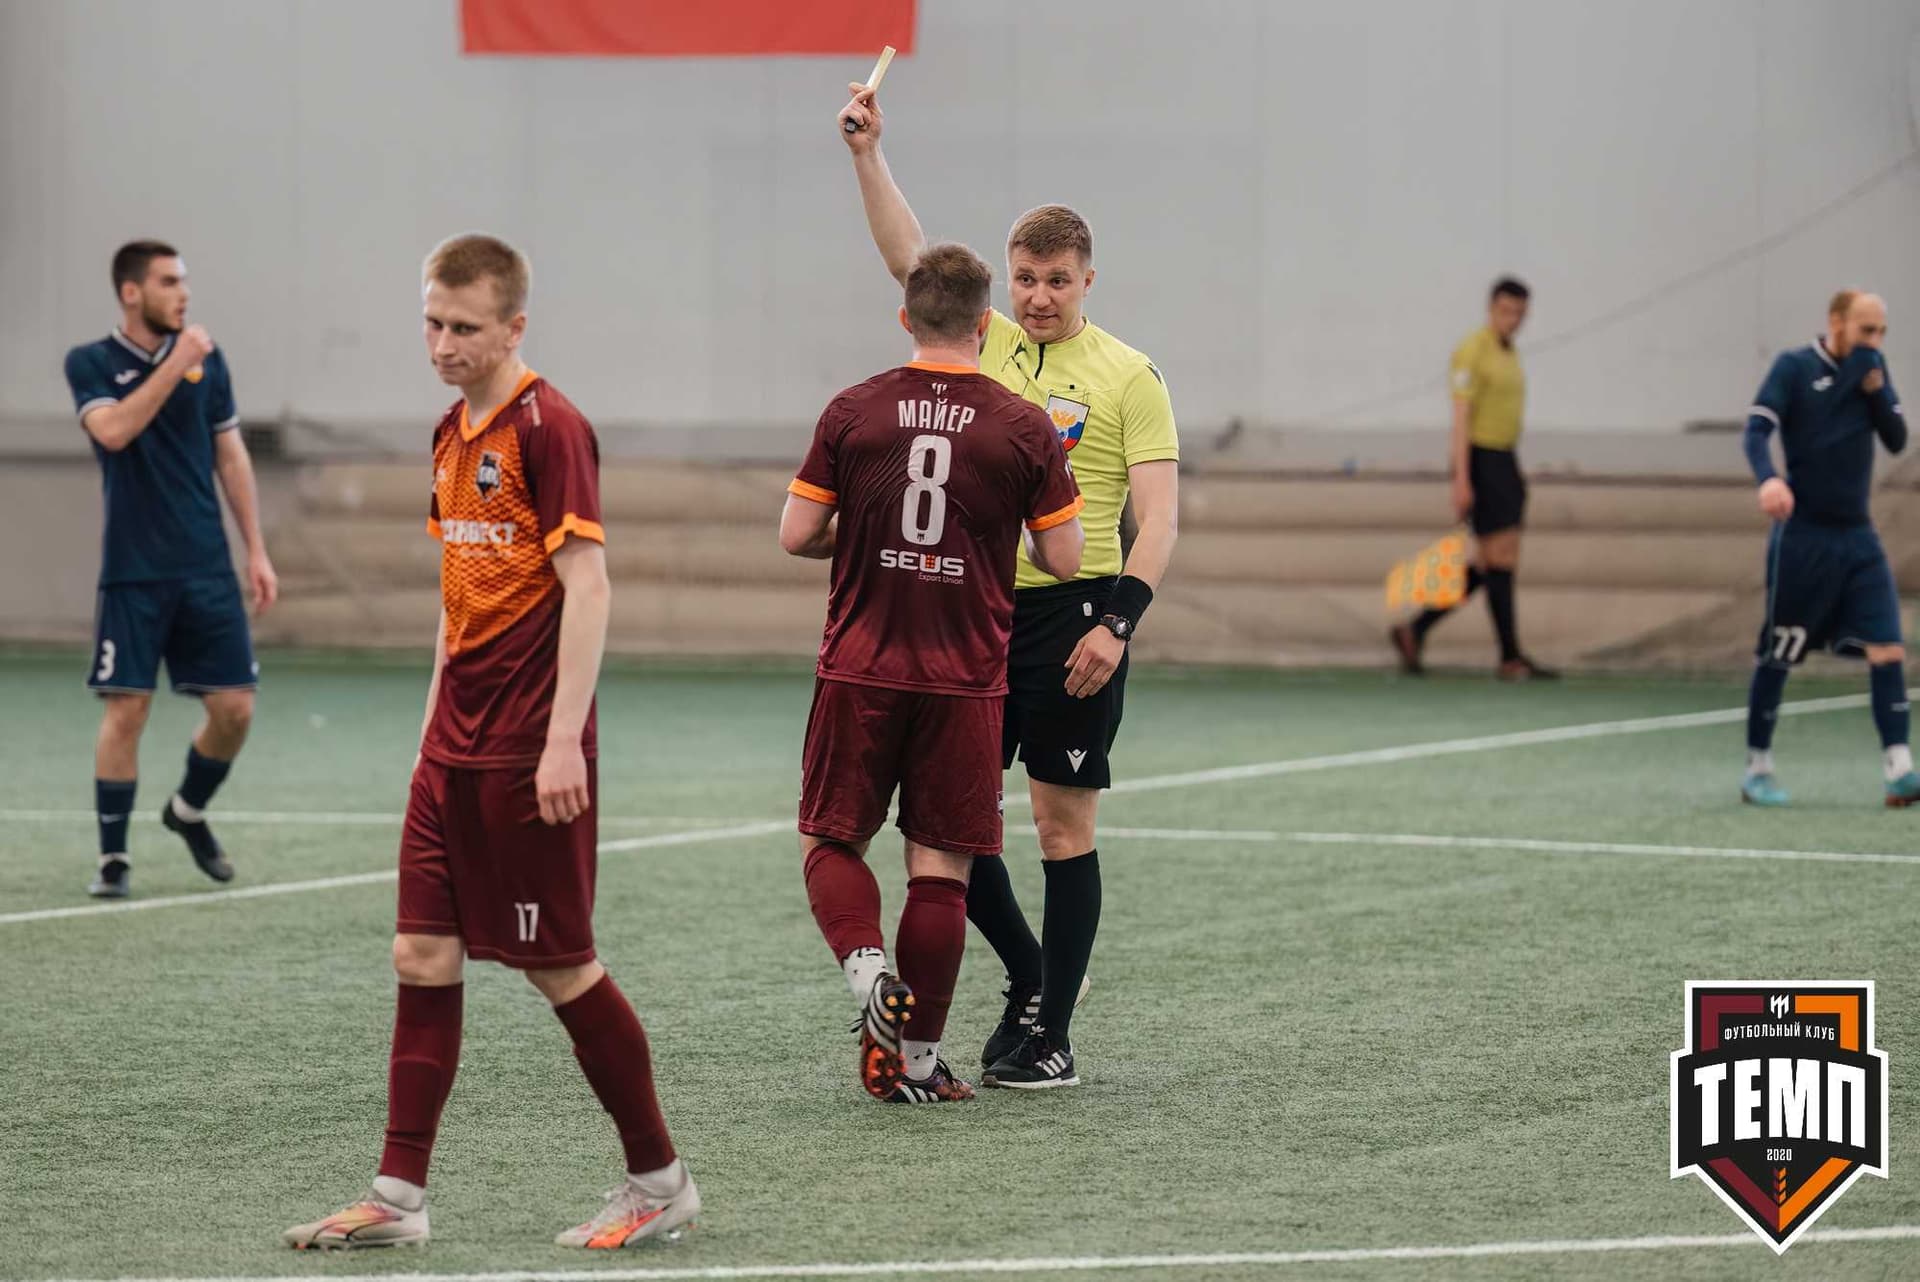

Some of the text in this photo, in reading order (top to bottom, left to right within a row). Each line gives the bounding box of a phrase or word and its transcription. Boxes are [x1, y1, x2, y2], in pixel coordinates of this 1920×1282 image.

[898, 398, 976, 433] МАЙЕР
[901, 434, 952, 546] 8
[880, 549, 965, 577] SEUS
[918, 572, 964, 585] Export Union
[97, 639, 116, 681] 3
[1773, 625, 1807, 662] 77
[514, 902, 539, 942] 17
